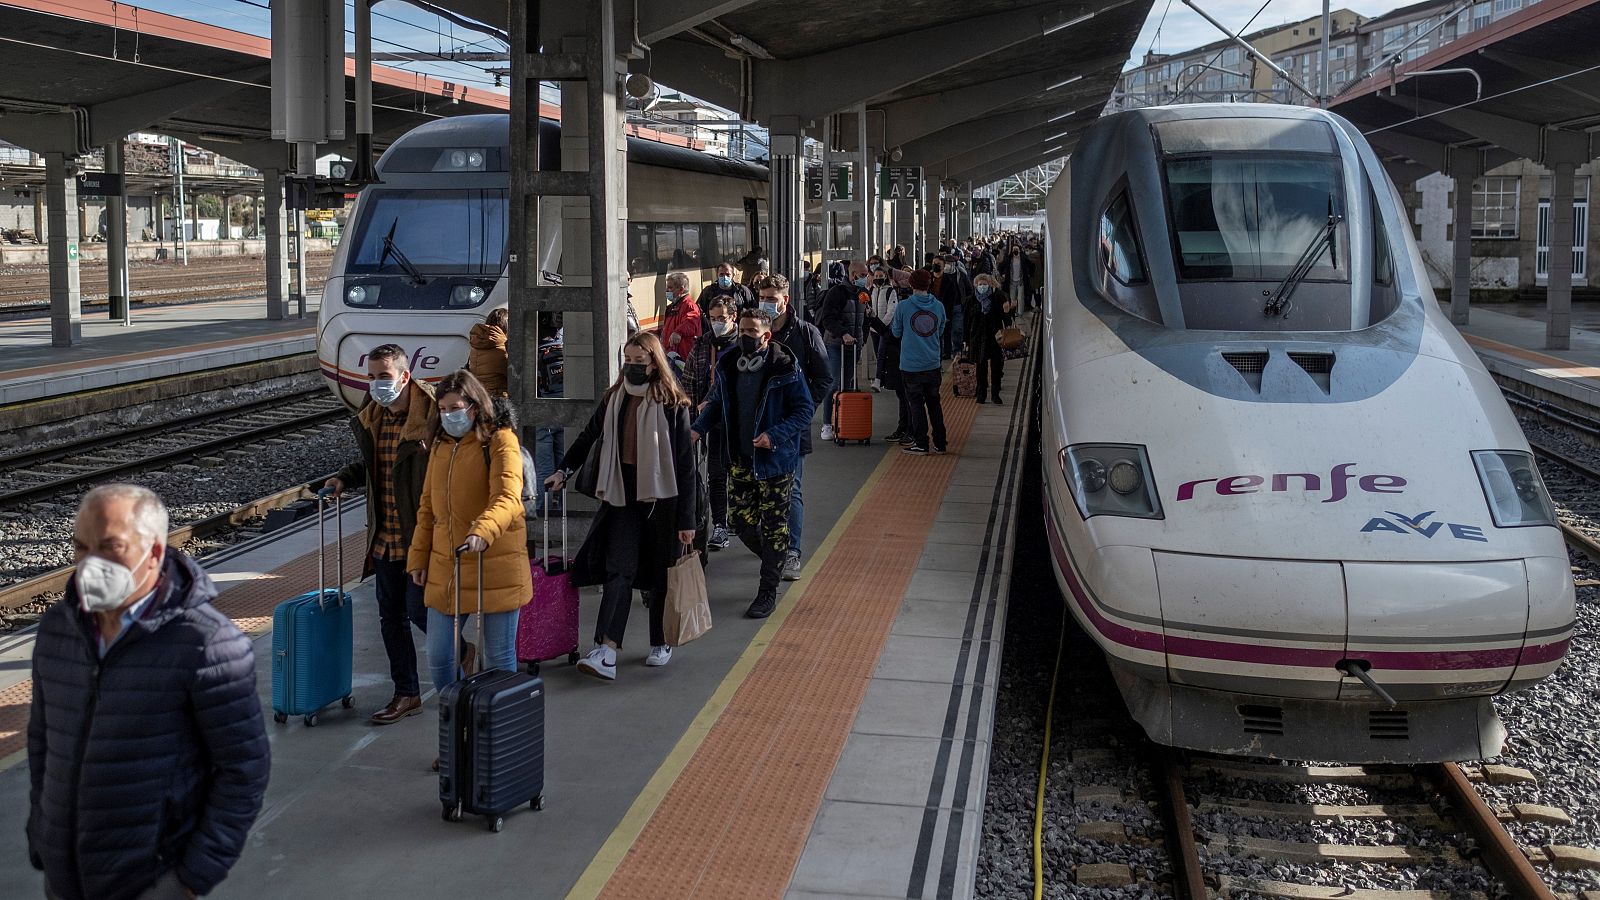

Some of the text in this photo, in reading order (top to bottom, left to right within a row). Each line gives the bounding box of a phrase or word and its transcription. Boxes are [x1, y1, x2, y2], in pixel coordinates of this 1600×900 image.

[814, 183, 822, 198] 3
[890, 183, 915, 198] A 2
[358, 347, 440, 376] rfe
[1176, 463, 1408, 503] renfe
[1360, 511, 1488, 542] AVE
